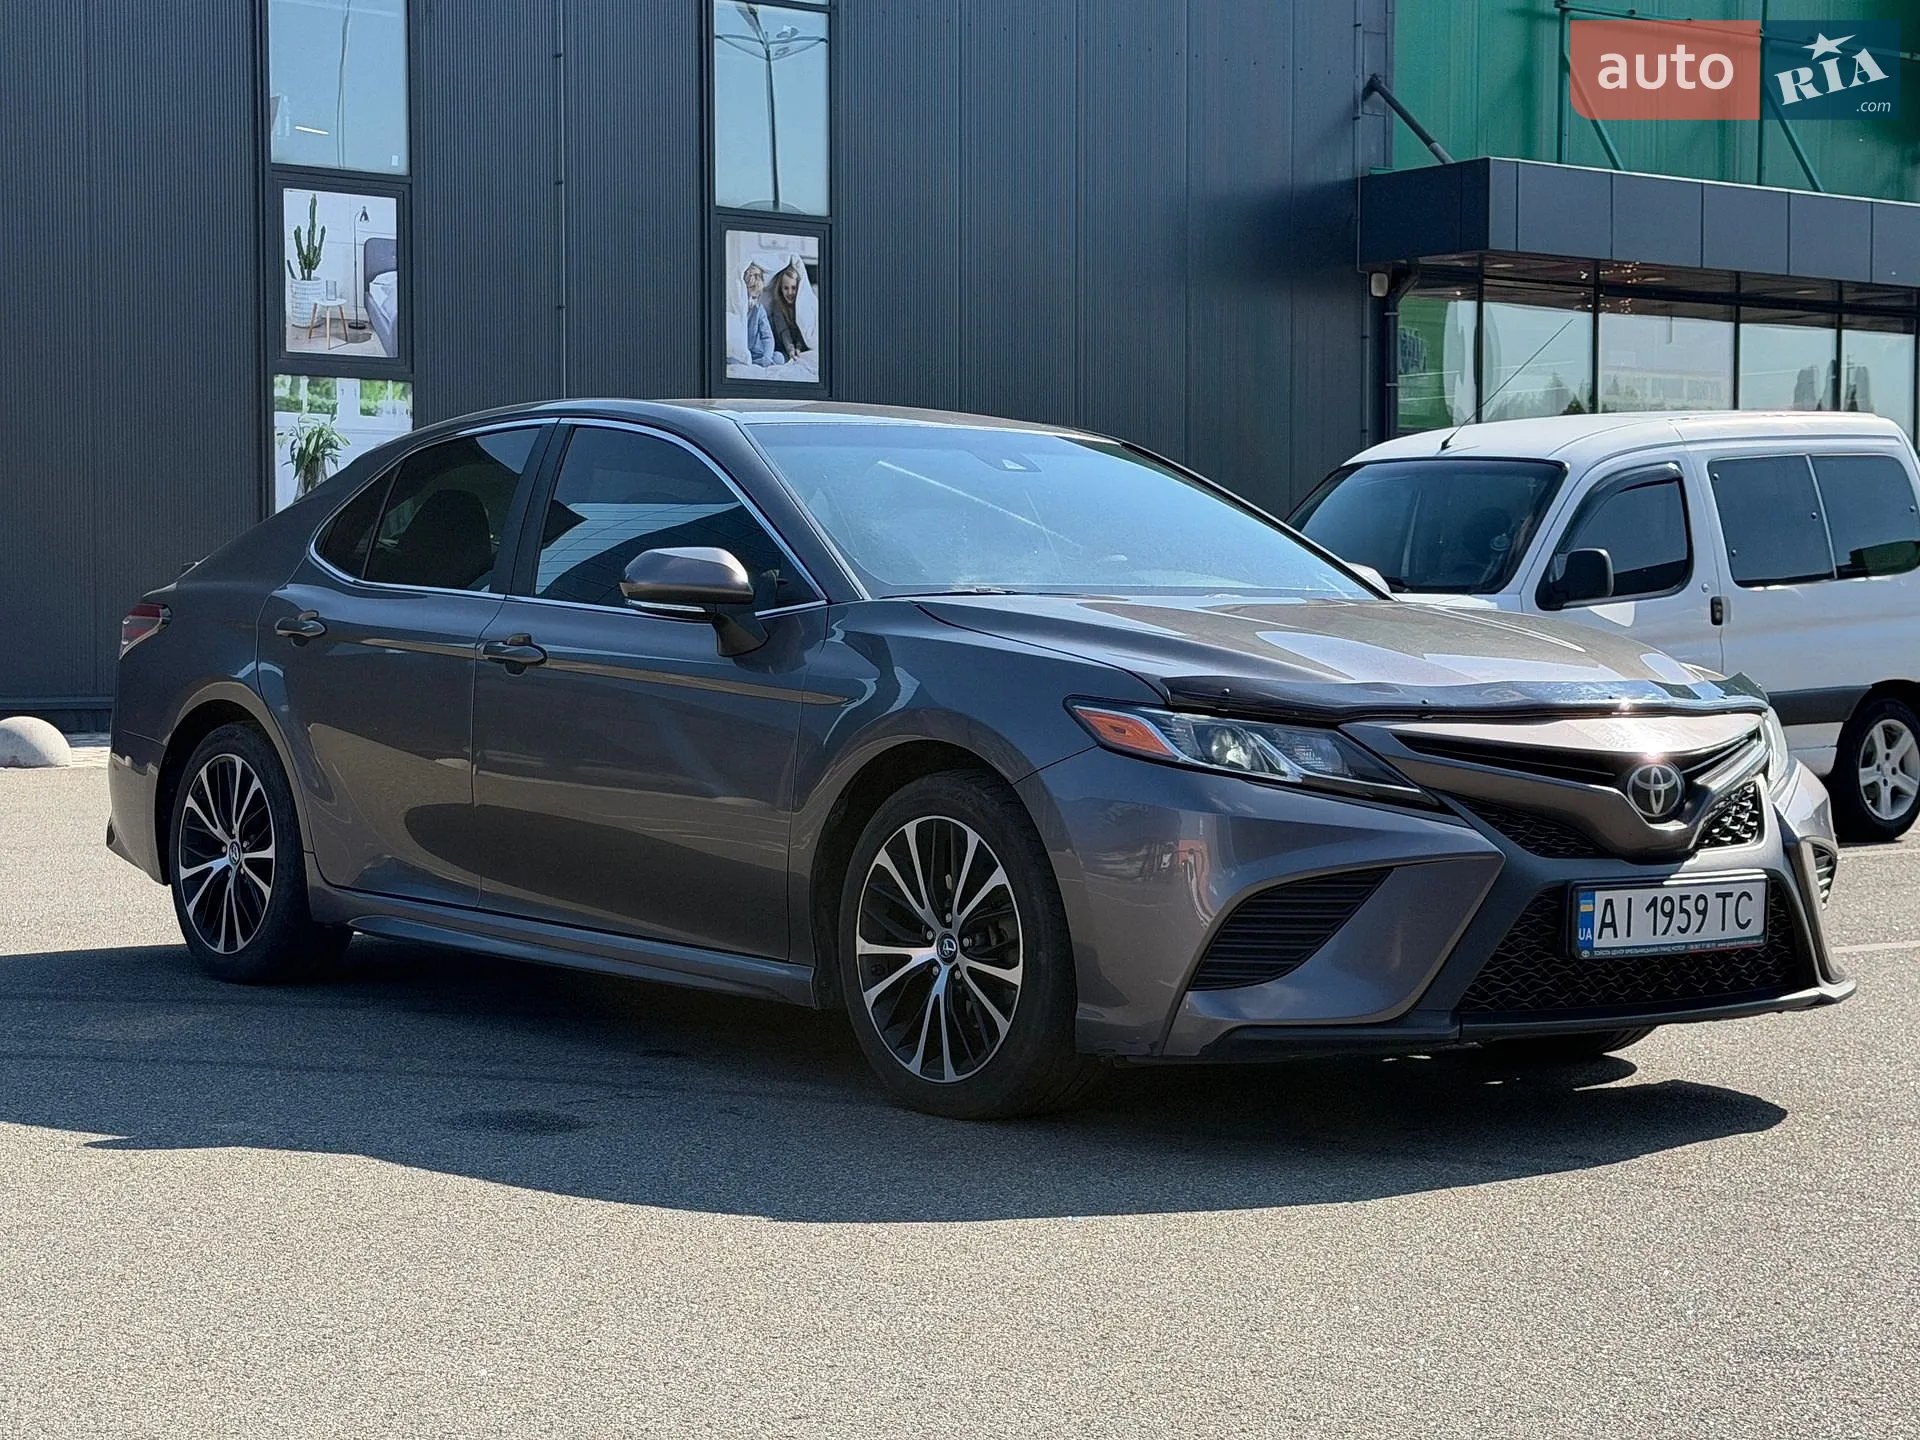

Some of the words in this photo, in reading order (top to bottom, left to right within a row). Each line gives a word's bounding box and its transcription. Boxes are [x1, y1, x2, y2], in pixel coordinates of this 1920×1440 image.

[1597, 897, 1633, 940] AI
[1645, 893, 1709, 937] 1959
[1715, 891, 1753, 932] TC
[1578, 927, 1593, 941] UA
